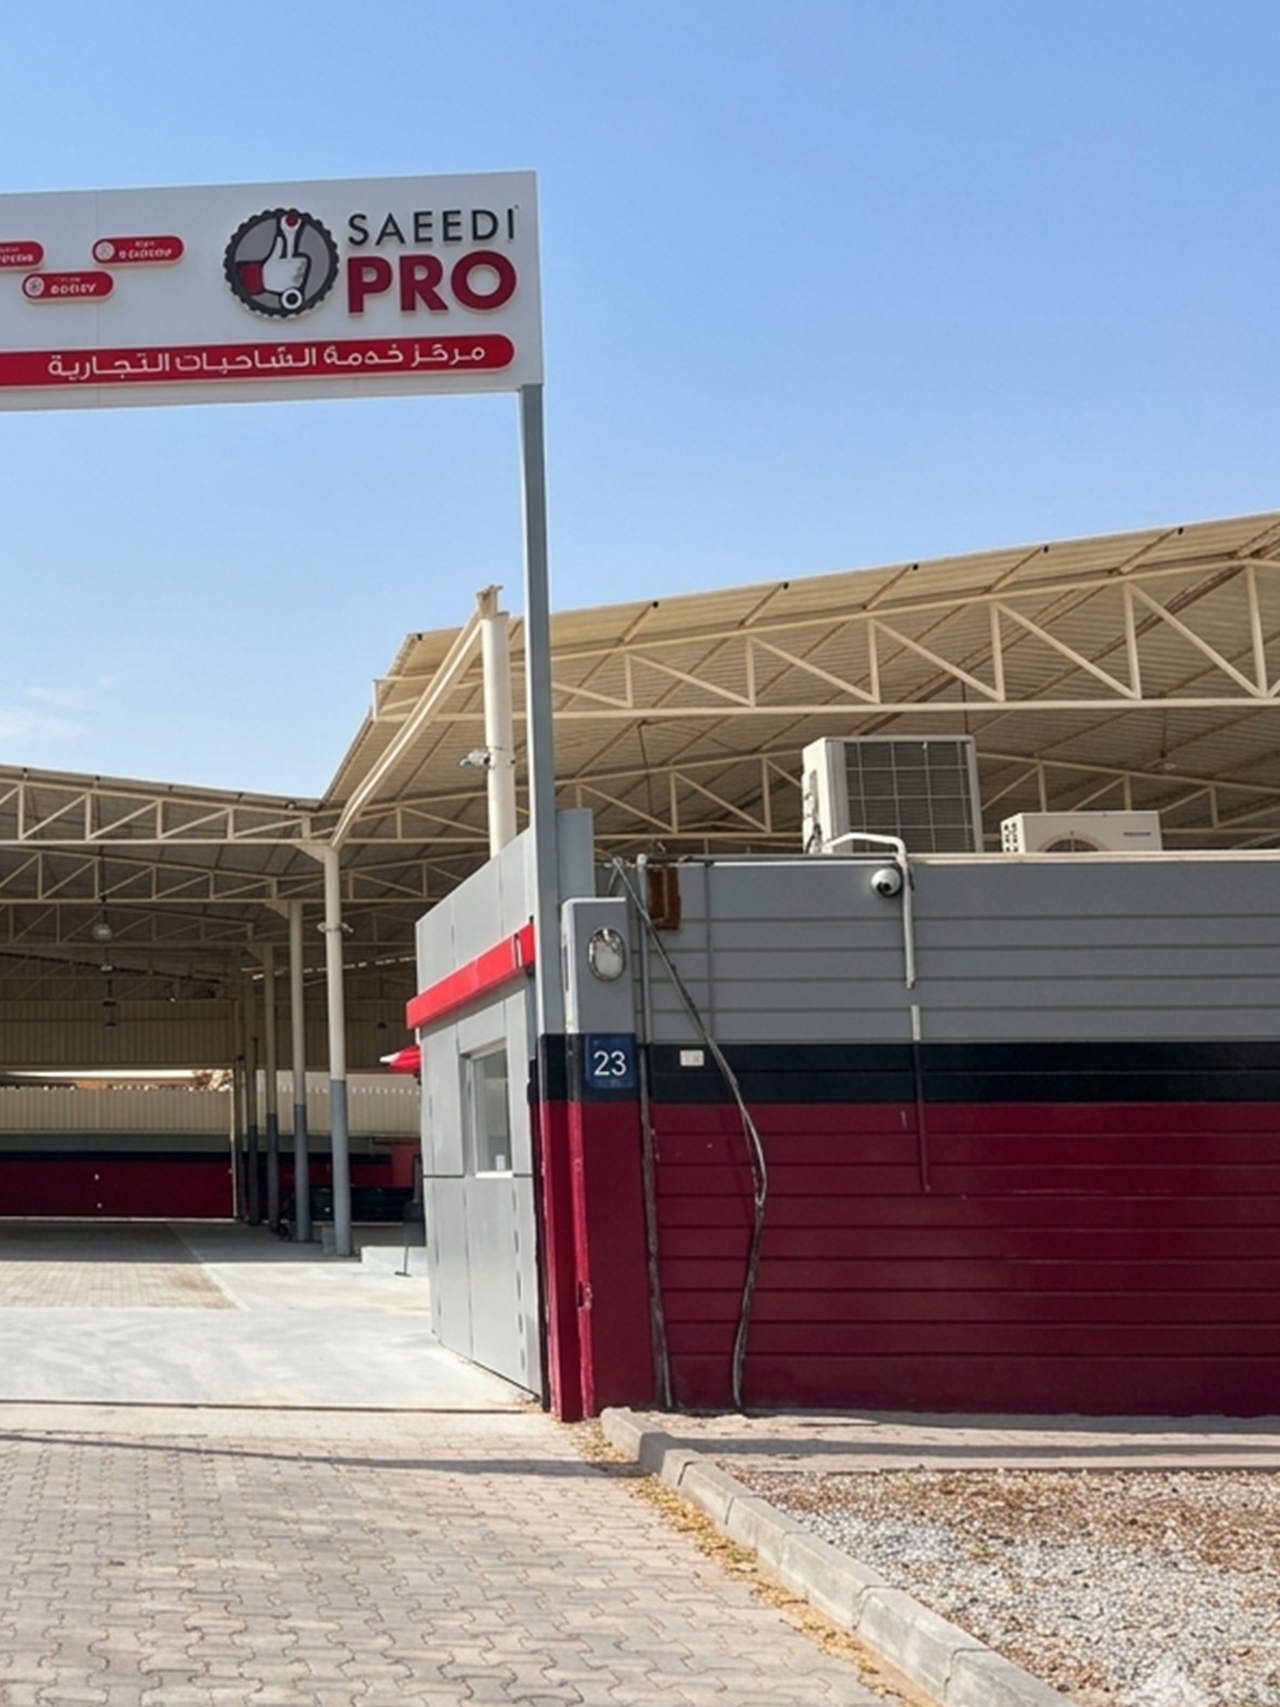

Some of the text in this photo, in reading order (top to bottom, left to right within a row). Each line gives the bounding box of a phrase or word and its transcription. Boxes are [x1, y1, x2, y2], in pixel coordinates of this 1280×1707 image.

[348, 208, 515, 246] SAEEDI
[347, 250, 517, 314] PRO
[593, 1050, 628, 1077] 23
